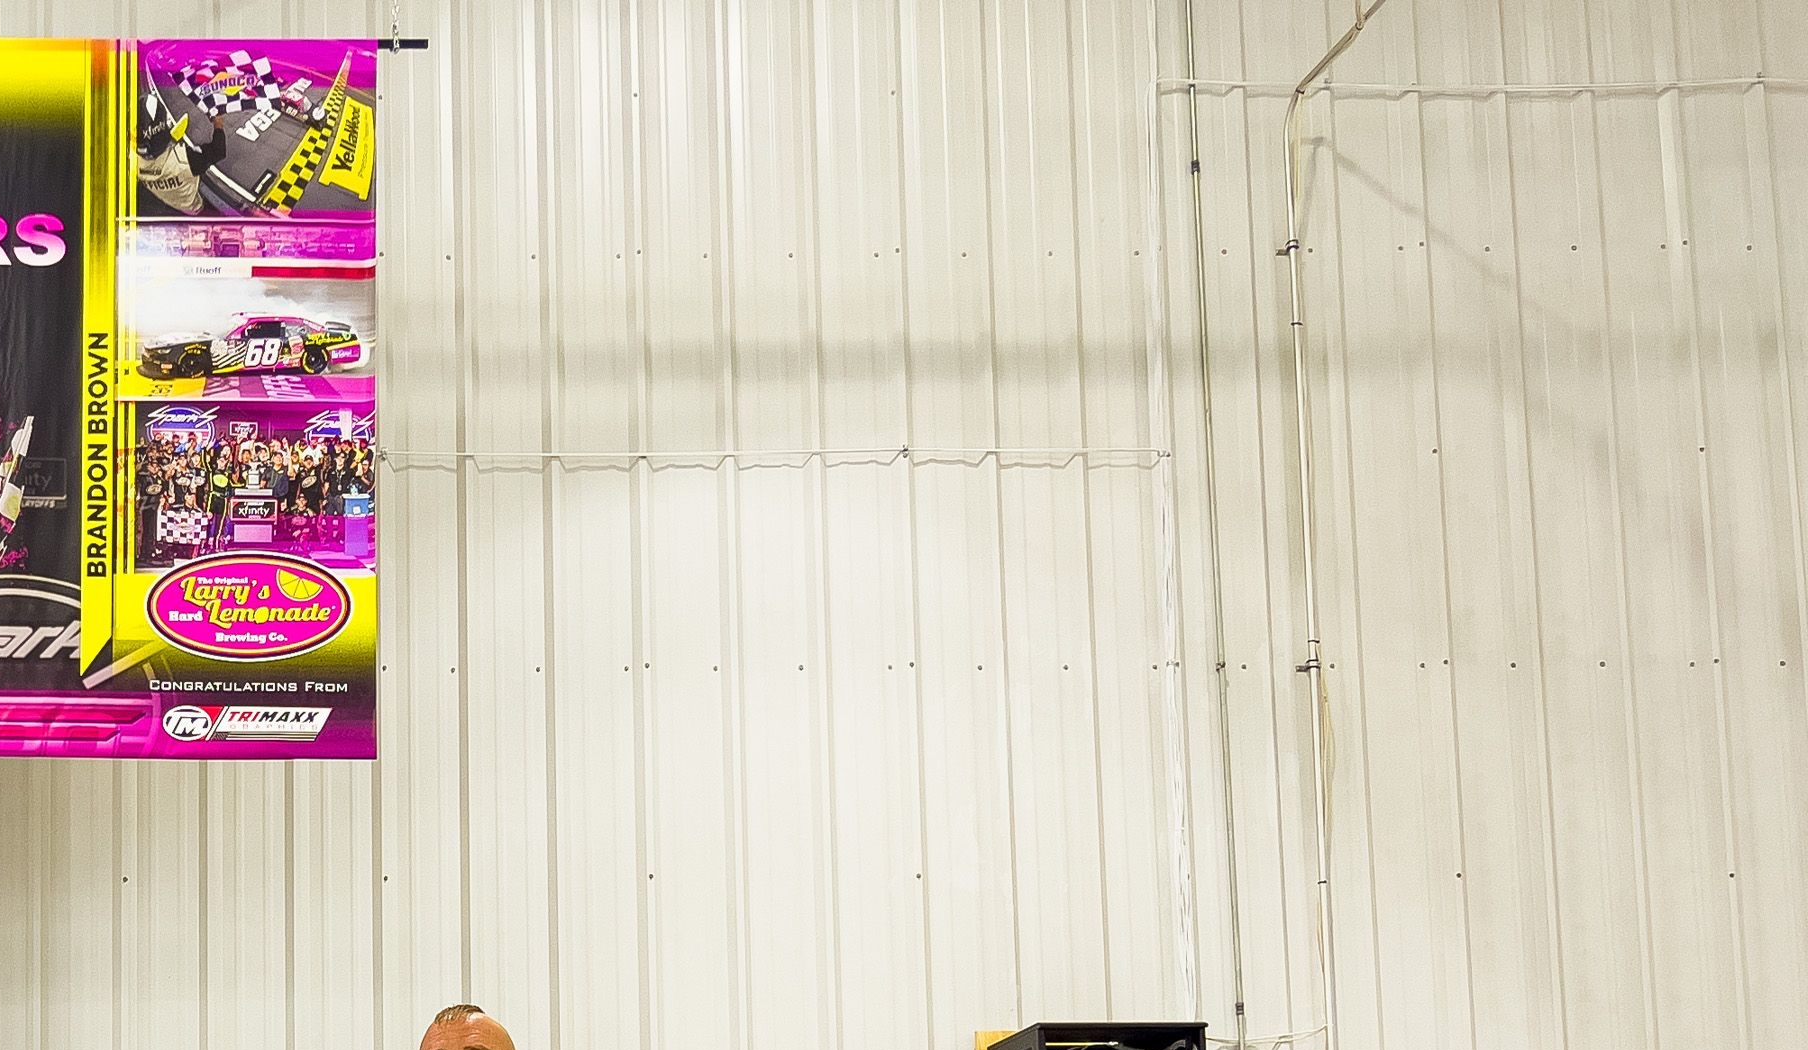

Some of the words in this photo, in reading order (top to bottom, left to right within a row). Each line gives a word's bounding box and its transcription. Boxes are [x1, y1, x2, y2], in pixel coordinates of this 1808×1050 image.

[244, 337, 284, 367] 68
[87, 332, 109, 435] BROWN
[86, 442, 108, 578] BRANDON
[180, 576, 271, 607] Larry's
[197, 576, 212, 585] The
[214, 576, 249, 586] Original
[168, 611, 204, 621] Hard
[205, 599, 331, 630] Lemonade
[215, 632, 267, 644] Brewing
[268, 632, 288, 642] Co.
[228, 711, 320, 723] TRIMAXX
